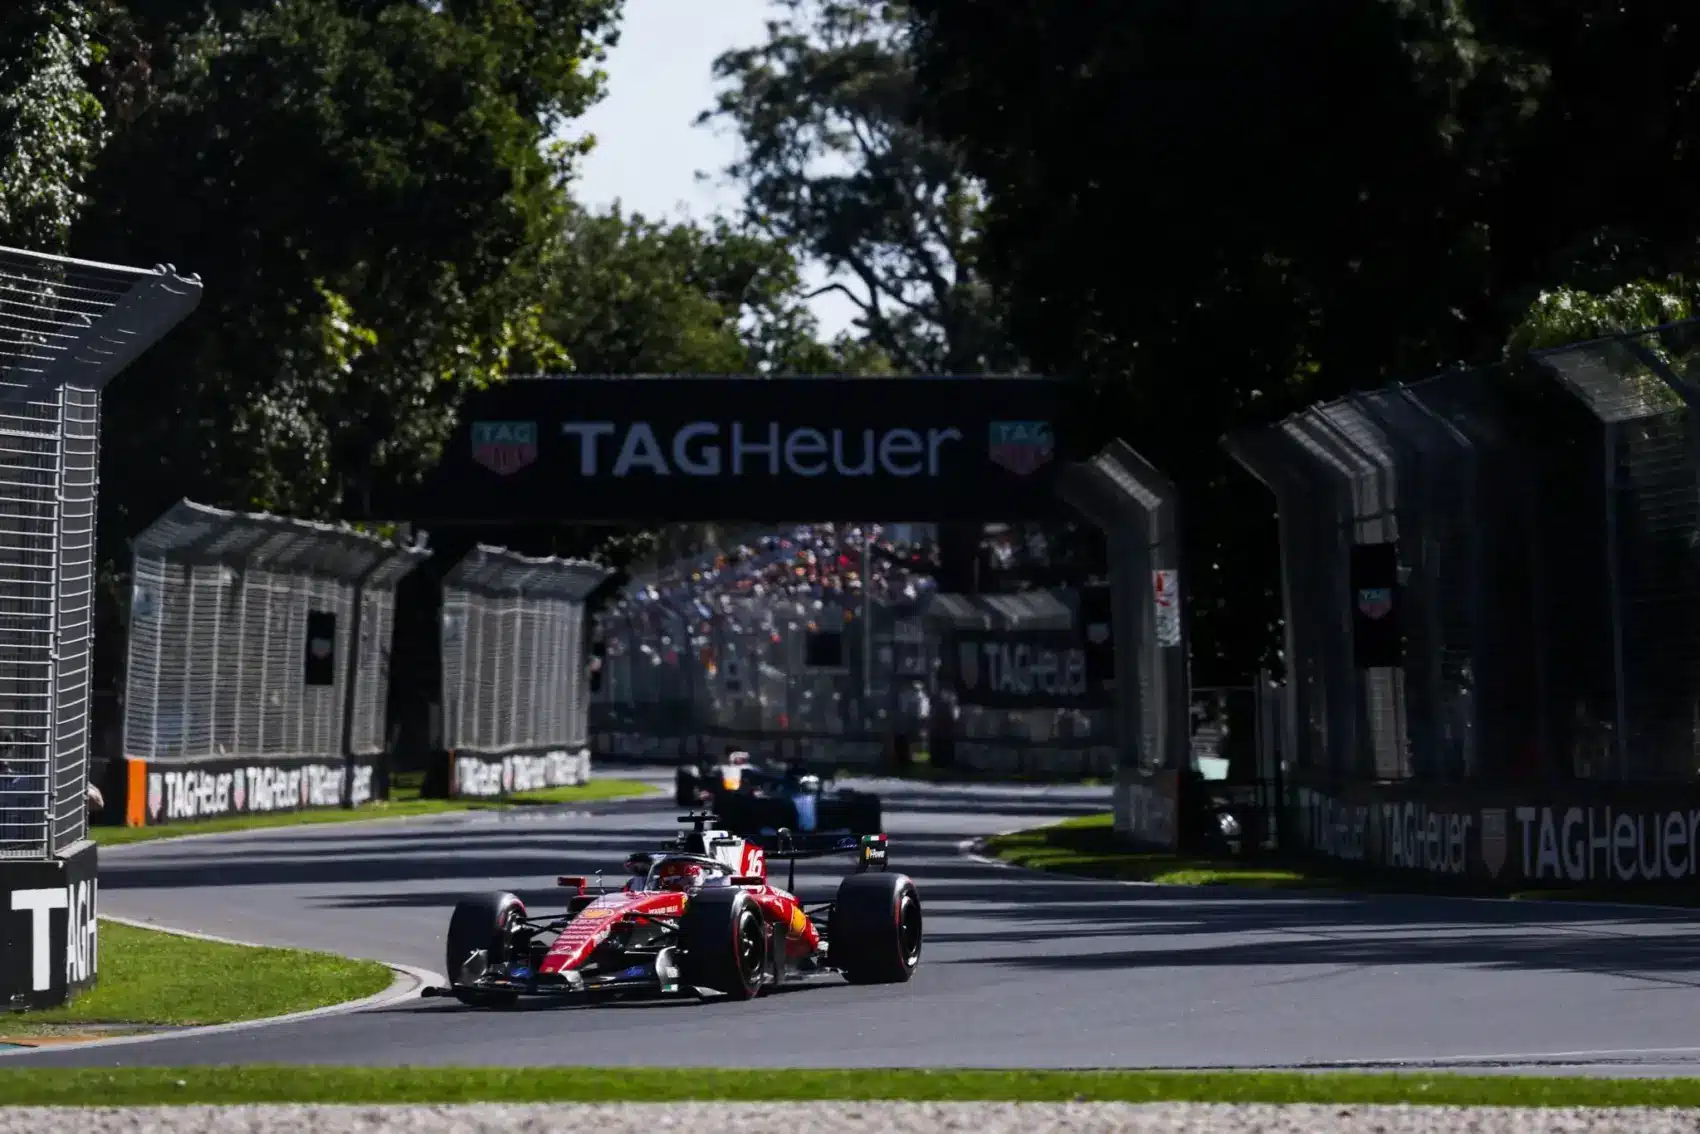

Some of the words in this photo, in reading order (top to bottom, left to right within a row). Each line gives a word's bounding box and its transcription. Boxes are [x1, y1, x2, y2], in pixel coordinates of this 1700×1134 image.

[480, 424, 530, 443] TAG
[560, 421, 962, 477] TAGHeuer
[165, 769, 233, 819] TAGHeuer
[746, 848, 764, 877] 16
